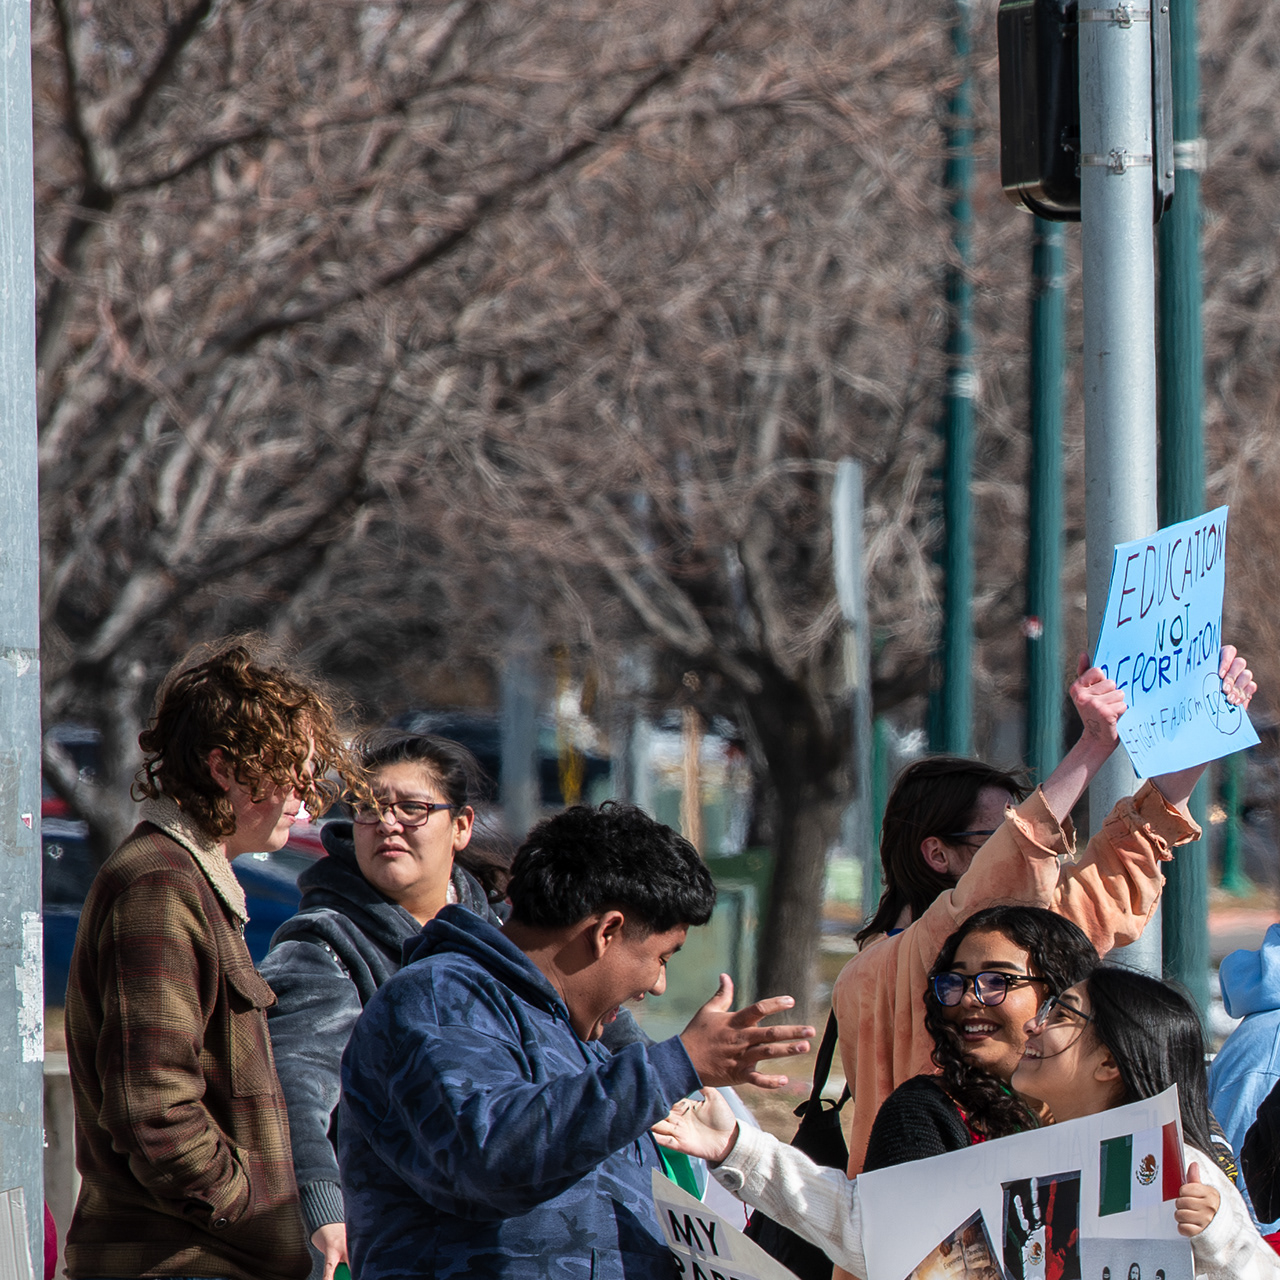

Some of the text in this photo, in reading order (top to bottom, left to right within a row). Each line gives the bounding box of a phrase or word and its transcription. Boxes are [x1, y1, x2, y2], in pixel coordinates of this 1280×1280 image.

[1117, 520, 1226, 628] EDUCATION
[1154, 603, 1191, 655] NOT
[667, 1209, 719, 1256] MY
